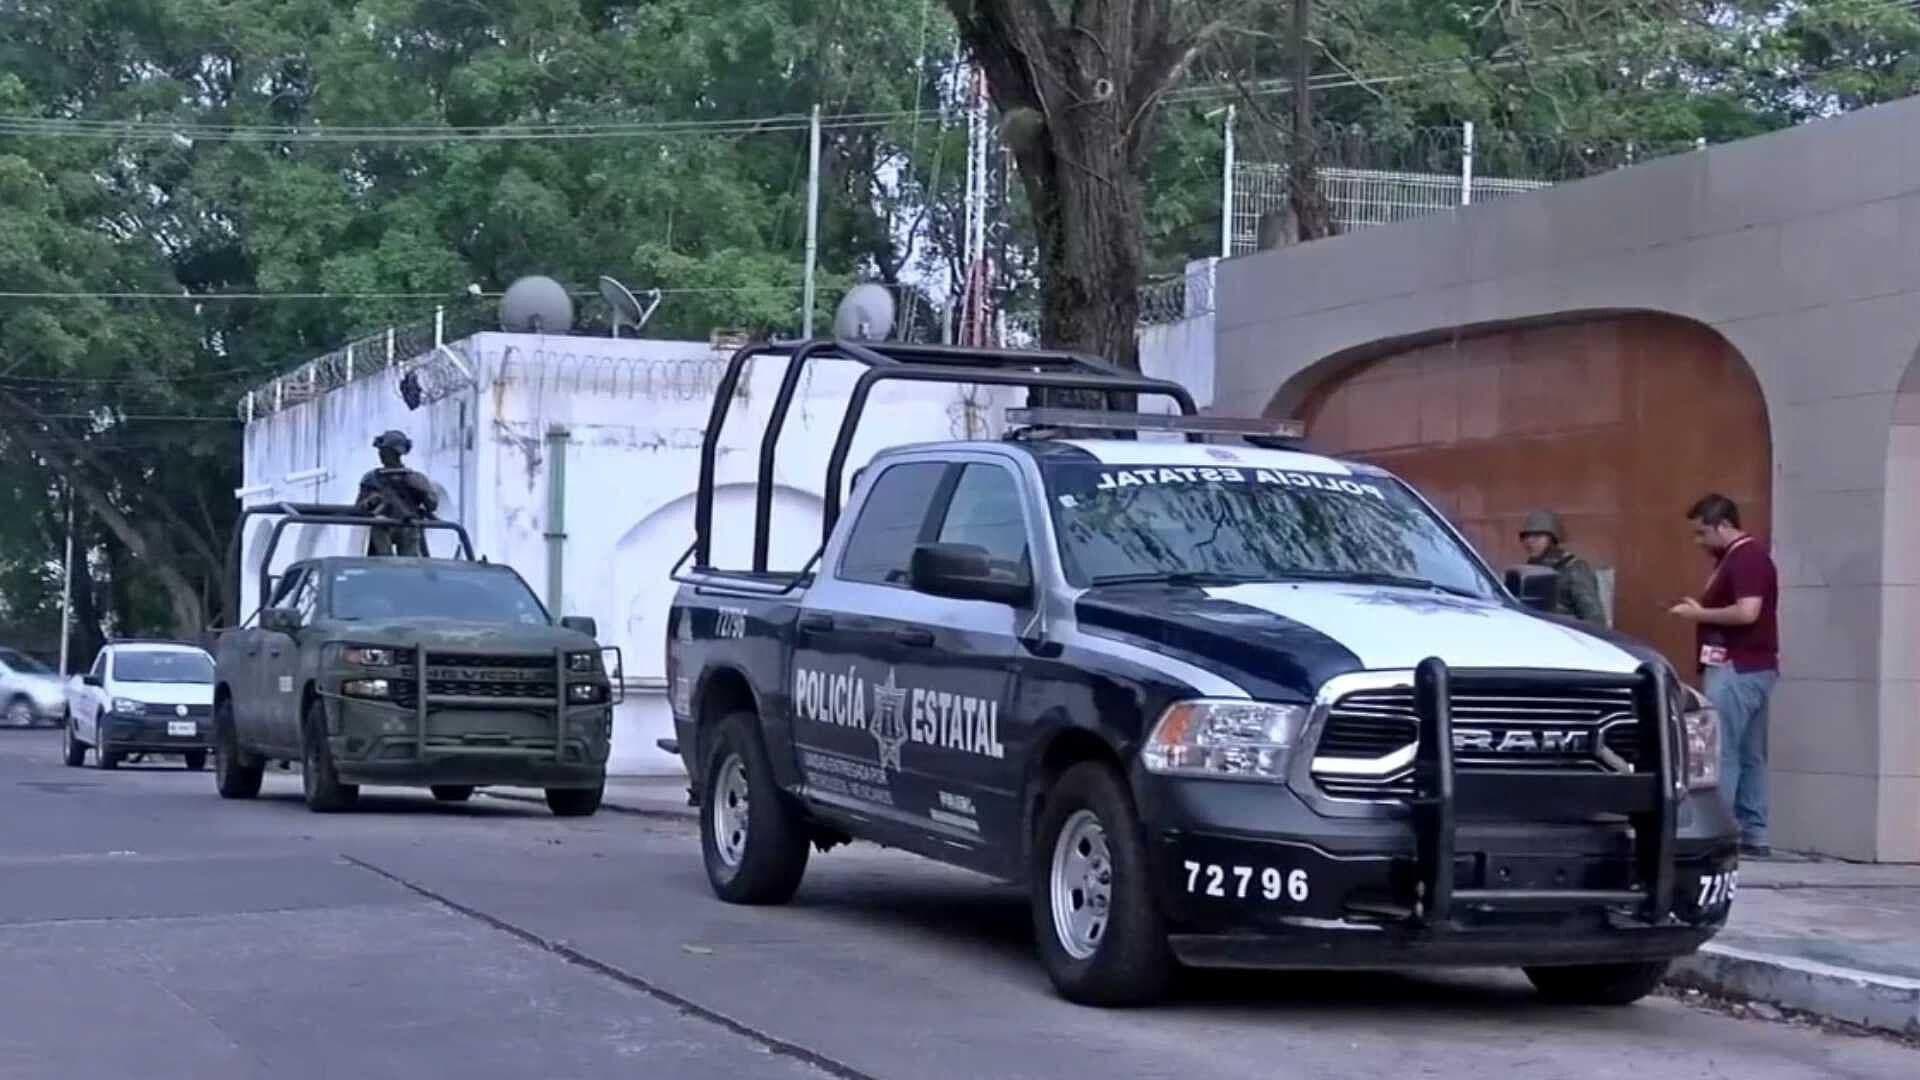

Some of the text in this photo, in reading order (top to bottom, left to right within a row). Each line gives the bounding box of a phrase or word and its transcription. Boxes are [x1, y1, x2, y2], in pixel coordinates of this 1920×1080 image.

[401, 665, 556, 682] CHEVROLE
[796, 665, 1005, 759] POLICÍA ESTATAL
[1452, 728, 1588, 752] RAM
[1184, 860, 1309, 902] 72796
